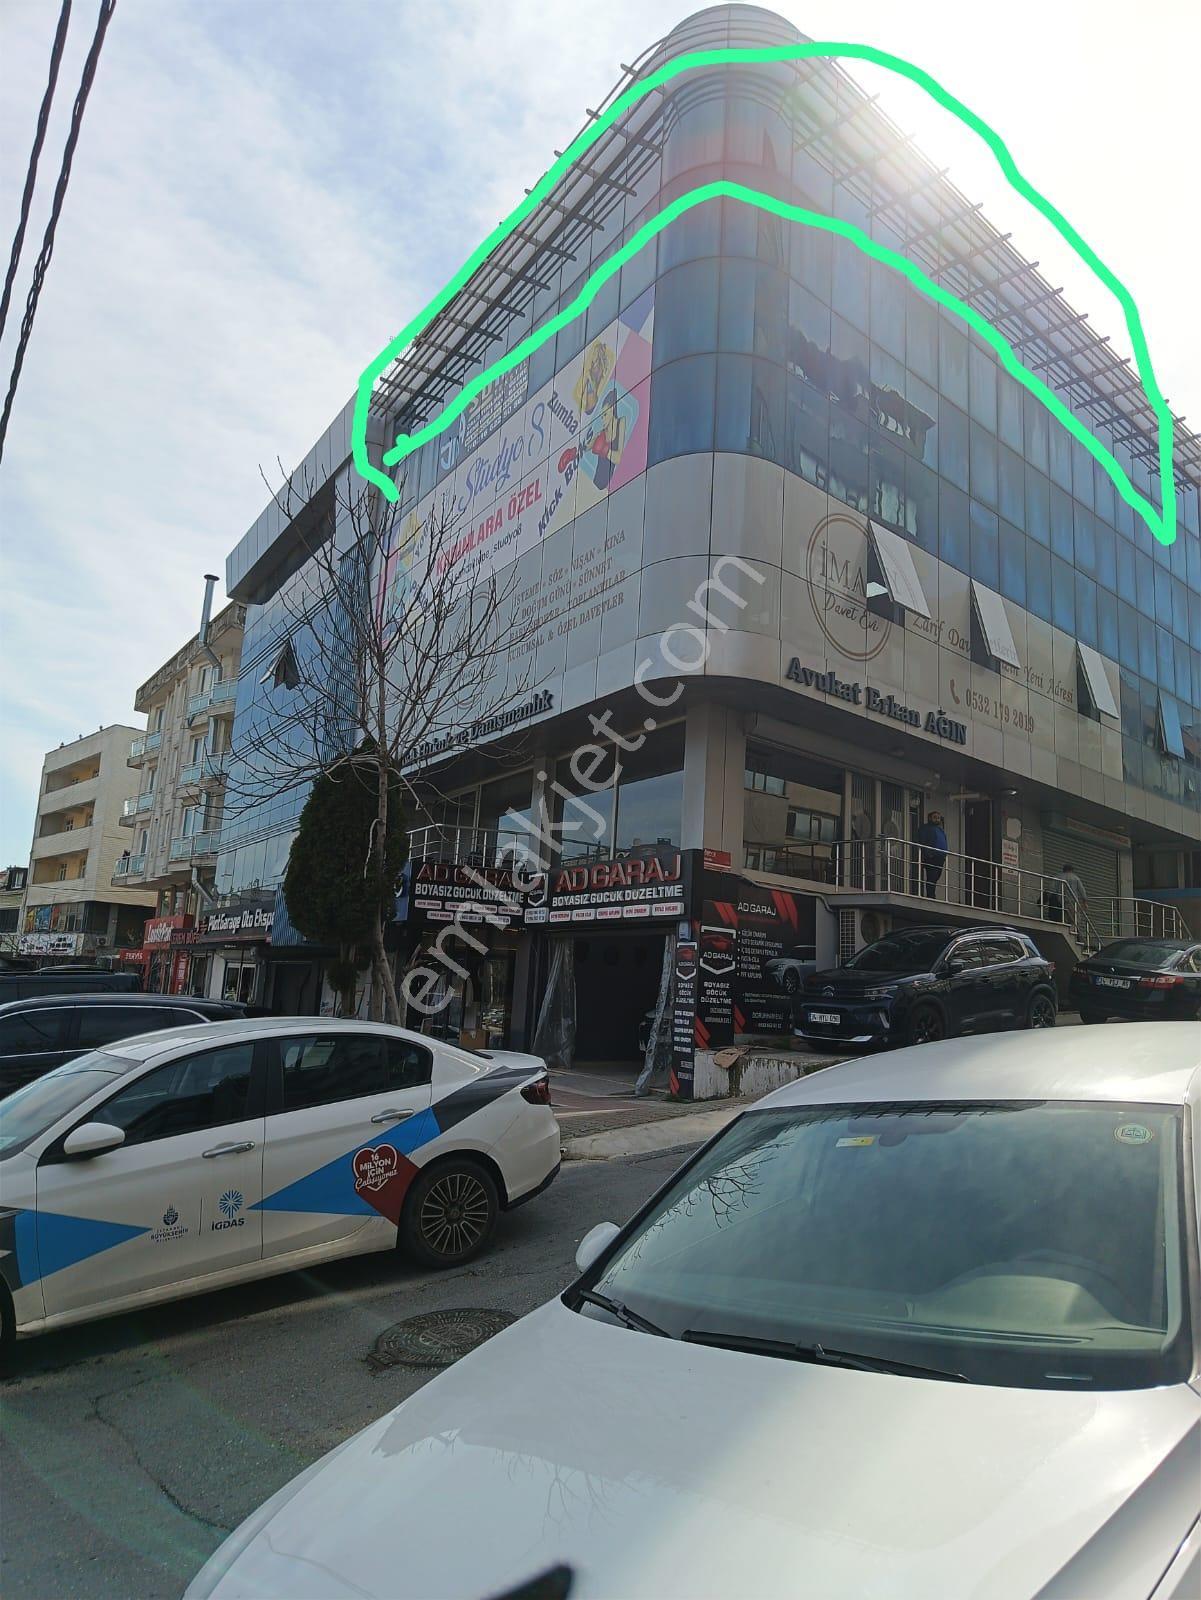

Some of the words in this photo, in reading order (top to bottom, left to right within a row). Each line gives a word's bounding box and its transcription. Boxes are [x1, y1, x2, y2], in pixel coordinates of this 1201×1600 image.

[507, 478, 543, 521] ÖZEL
[822, 592, 859, 621] Davet
[786, 657, 862, 705] Avukat
[866, 686, 922, 728] Erkan
[925, 706, 968, 745] AĞIN
[1024, 666, 1044, 689] Yeni
[1046, 678, 1074, 703] Adresi
[965, 689, 990, 715] 0532
[1013, 709, 1035, 733] 2019
[415, 882, 452, 897] BOYASIZ
[556, 868, 589, 893] AD
[591, 854, 681, 888] GARAJ
[552, 894, 590, 907] BOYASIZ
[738, 902, 749, 912] AD
[750, 904, 777, 916] GARAJ
[360, 1158, 391, 1171] MİLYON
